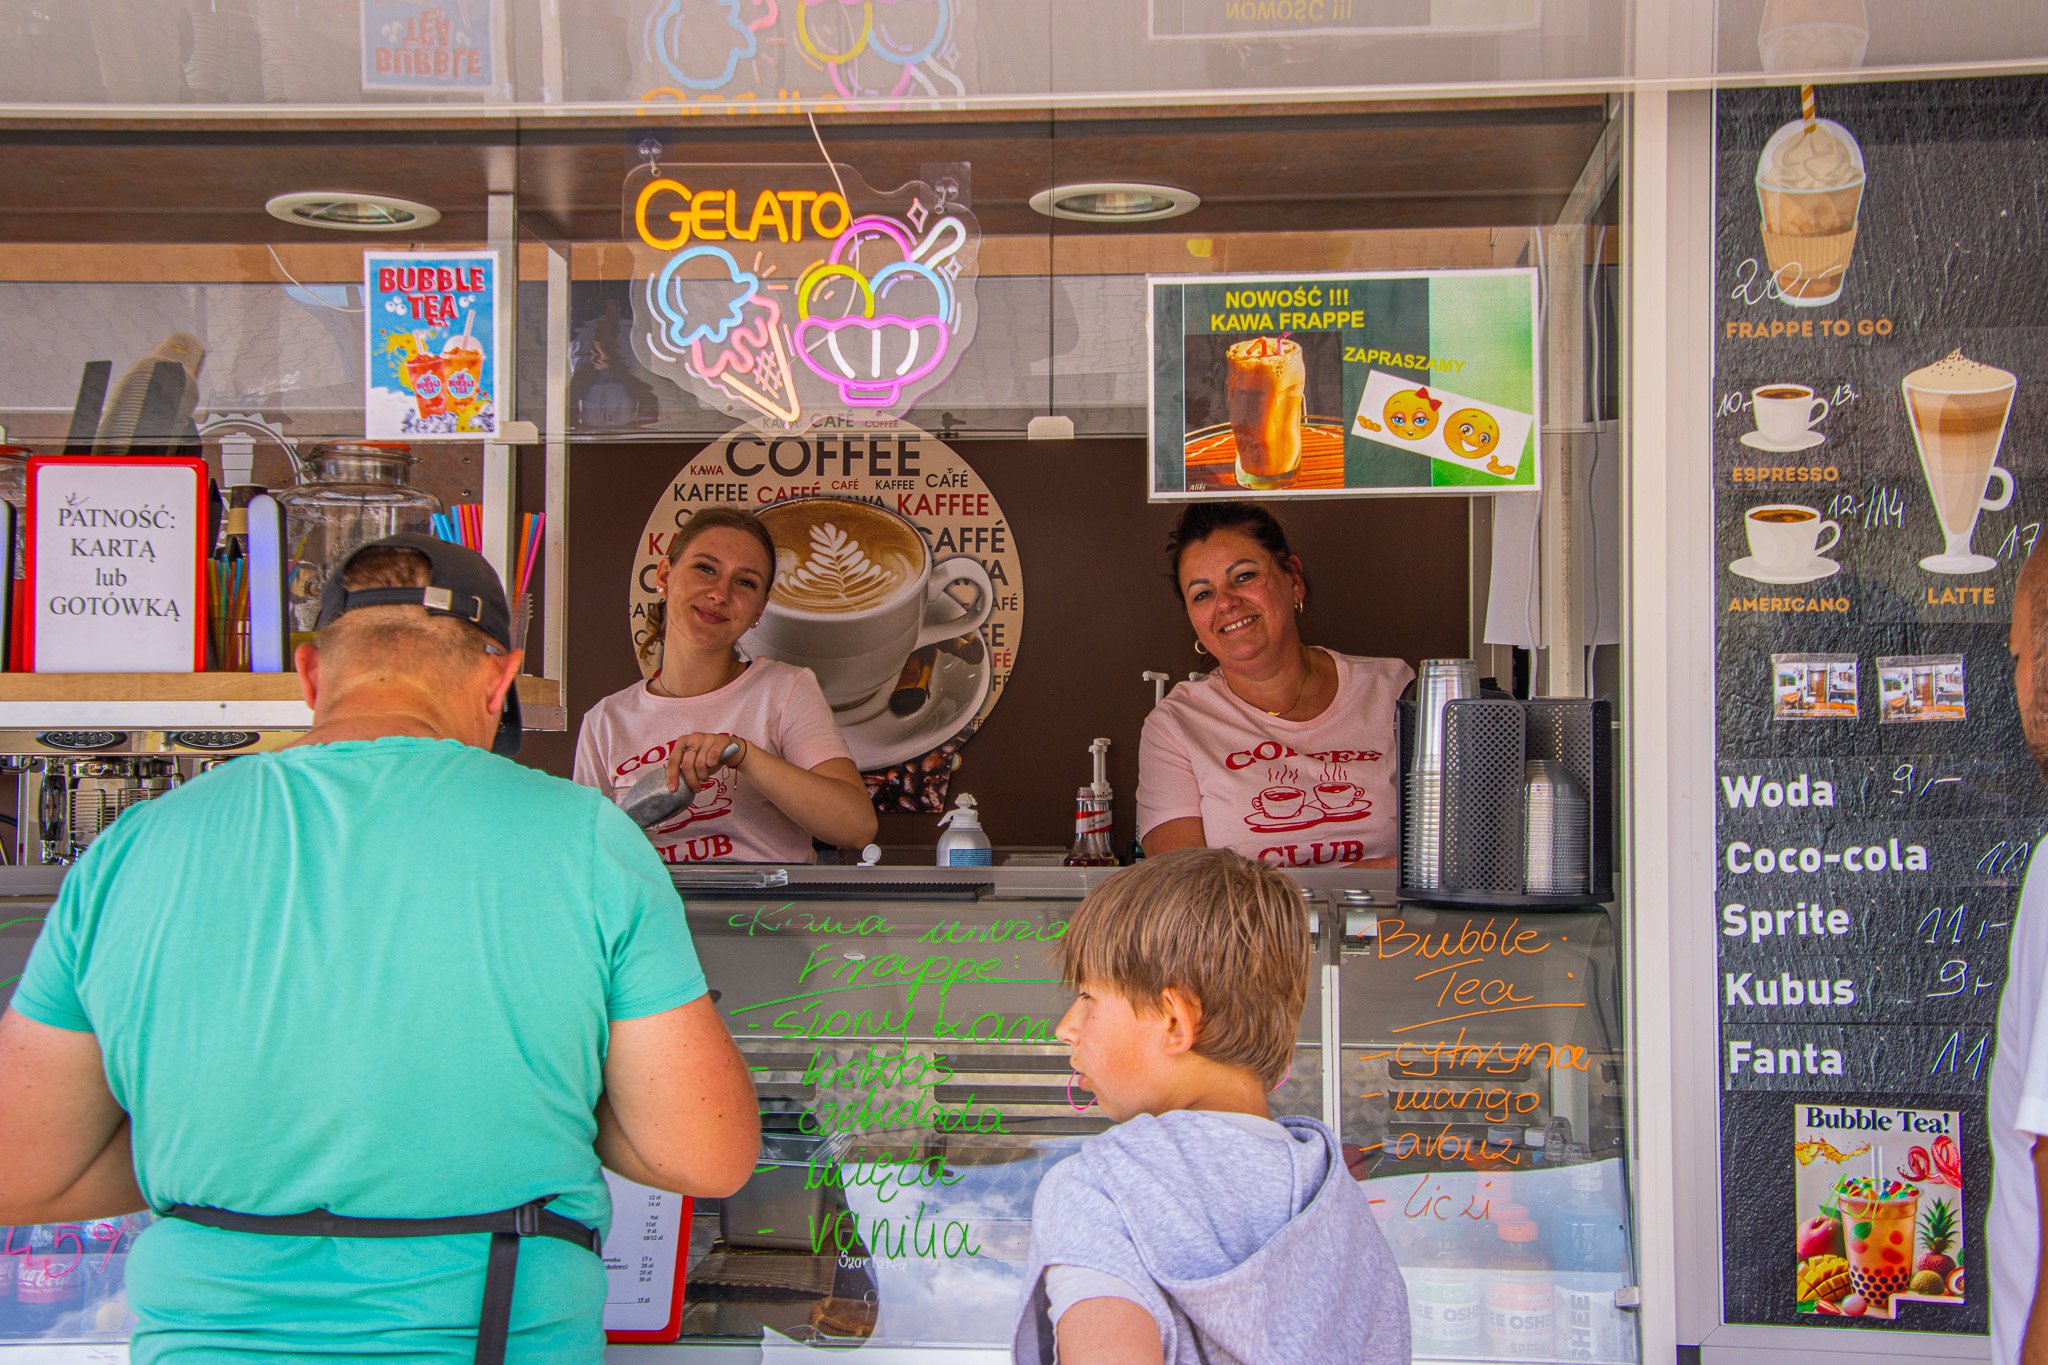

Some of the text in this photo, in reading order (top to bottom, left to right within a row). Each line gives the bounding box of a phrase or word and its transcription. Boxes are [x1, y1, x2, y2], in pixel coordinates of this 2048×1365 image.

[635, 178, 851, 250] GELATO
[378, 267, 485, 294] BUBBLE
[406, 293, 459, 321] TEA
[1225, 286, 1349, 308] NOWOŚĆ !!!
[1210, 310, 1365, 331] KAWA FRAPPE
[1725, 318, 1893, 339] FRAPPE TO GO
[1343, 346, 1466, 374] ZAPRASZAMY
[865, 419, 899, 429] COFFEE
[725, 433, 921, 478] COFFEE
[690, 465, 724, 477] KAWA
[925, 470, 968, 488] CAFÉ
[1731, 466, 1839, 483] ESPRESSO
[673, 483, 748, 502] KAFFEE
[831, 478, 860, 491] CAFÉ
[875, 479, 915, 491] KAFFEE
[897, 493, 989, 517] KAFFEE
[69, 538, 157, 563] KARTĄ
[95, 567, 128, 587] lub
[49, 591, 181, 622] GOTÓWKĄ
[1728, 596, 1850, 613] AMERICANO
[1926, 587, 1996, 606] LATTE
[1721, 774, 1835, 809] Woda
[1725, 838, 1929, 874] Coco-cola
[1722, 902, 1850, 943] Sprite
[1725, 973, 1856, 1006] Kubus
[1728, 1041, 1844, 1075] Fanta
[1806, 1106, 1951, 1134] Bubble Tea!
